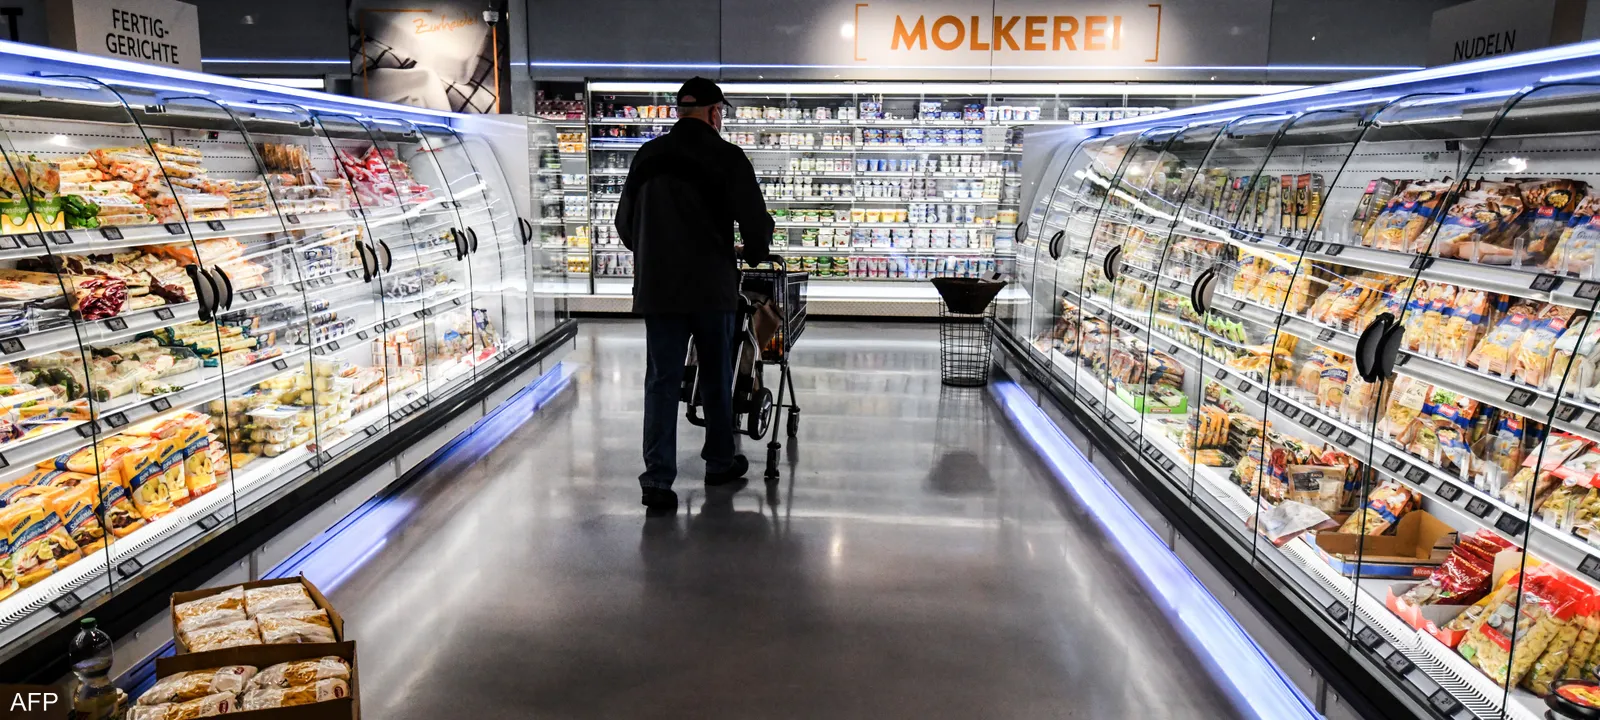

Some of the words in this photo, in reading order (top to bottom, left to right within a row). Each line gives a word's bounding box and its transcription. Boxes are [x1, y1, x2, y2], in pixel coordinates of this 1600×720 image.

[112, 8, 169, 38] FERTIG-
[890, 14, 1122, 51] MOLKEREI
[106, 33, 179, 64] GERICHTE
[1453, 29, 1516, 61] NUDELN
